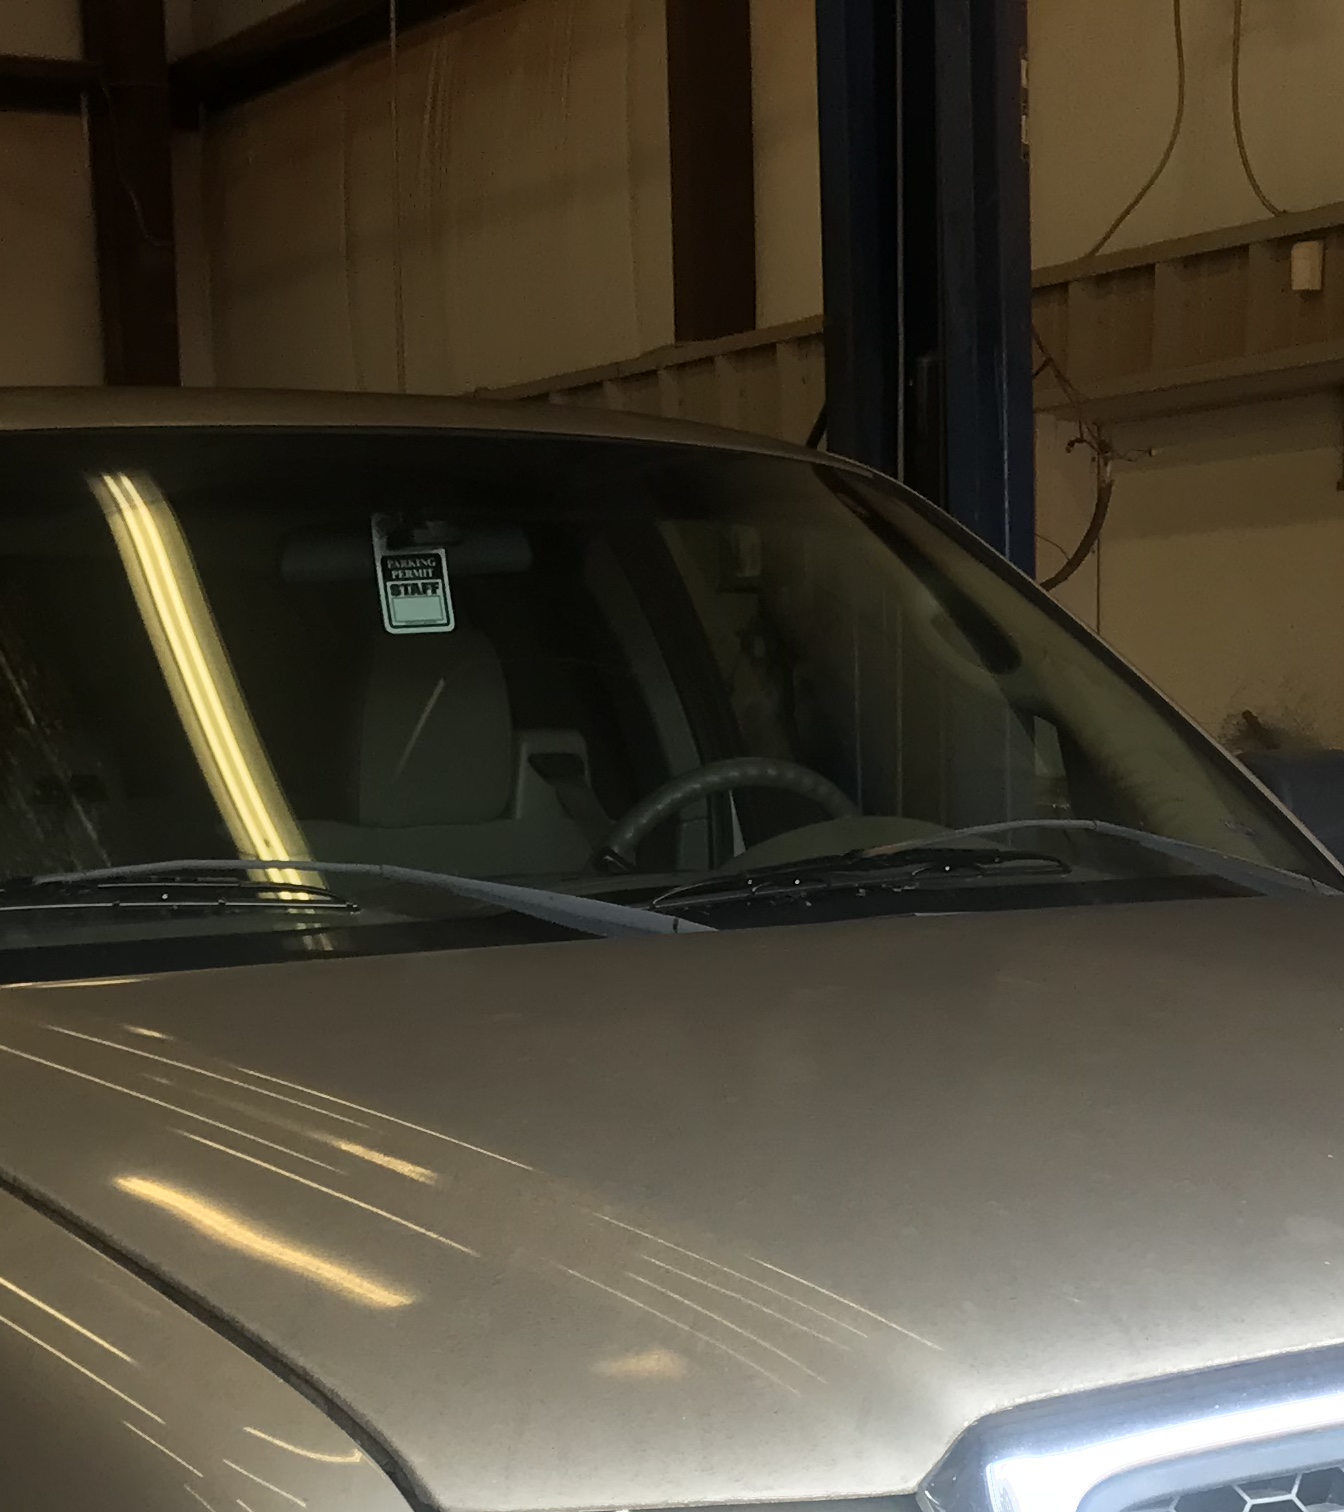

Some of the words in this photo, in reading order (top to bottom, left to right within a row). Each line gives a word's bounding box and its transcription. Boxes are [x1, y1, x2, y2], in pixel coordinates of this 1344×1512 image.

[387, 558, 436, 569] PARKING
[391, 568, 433, 579] PERMIT
[390, 582, 440, 597] STAFF
